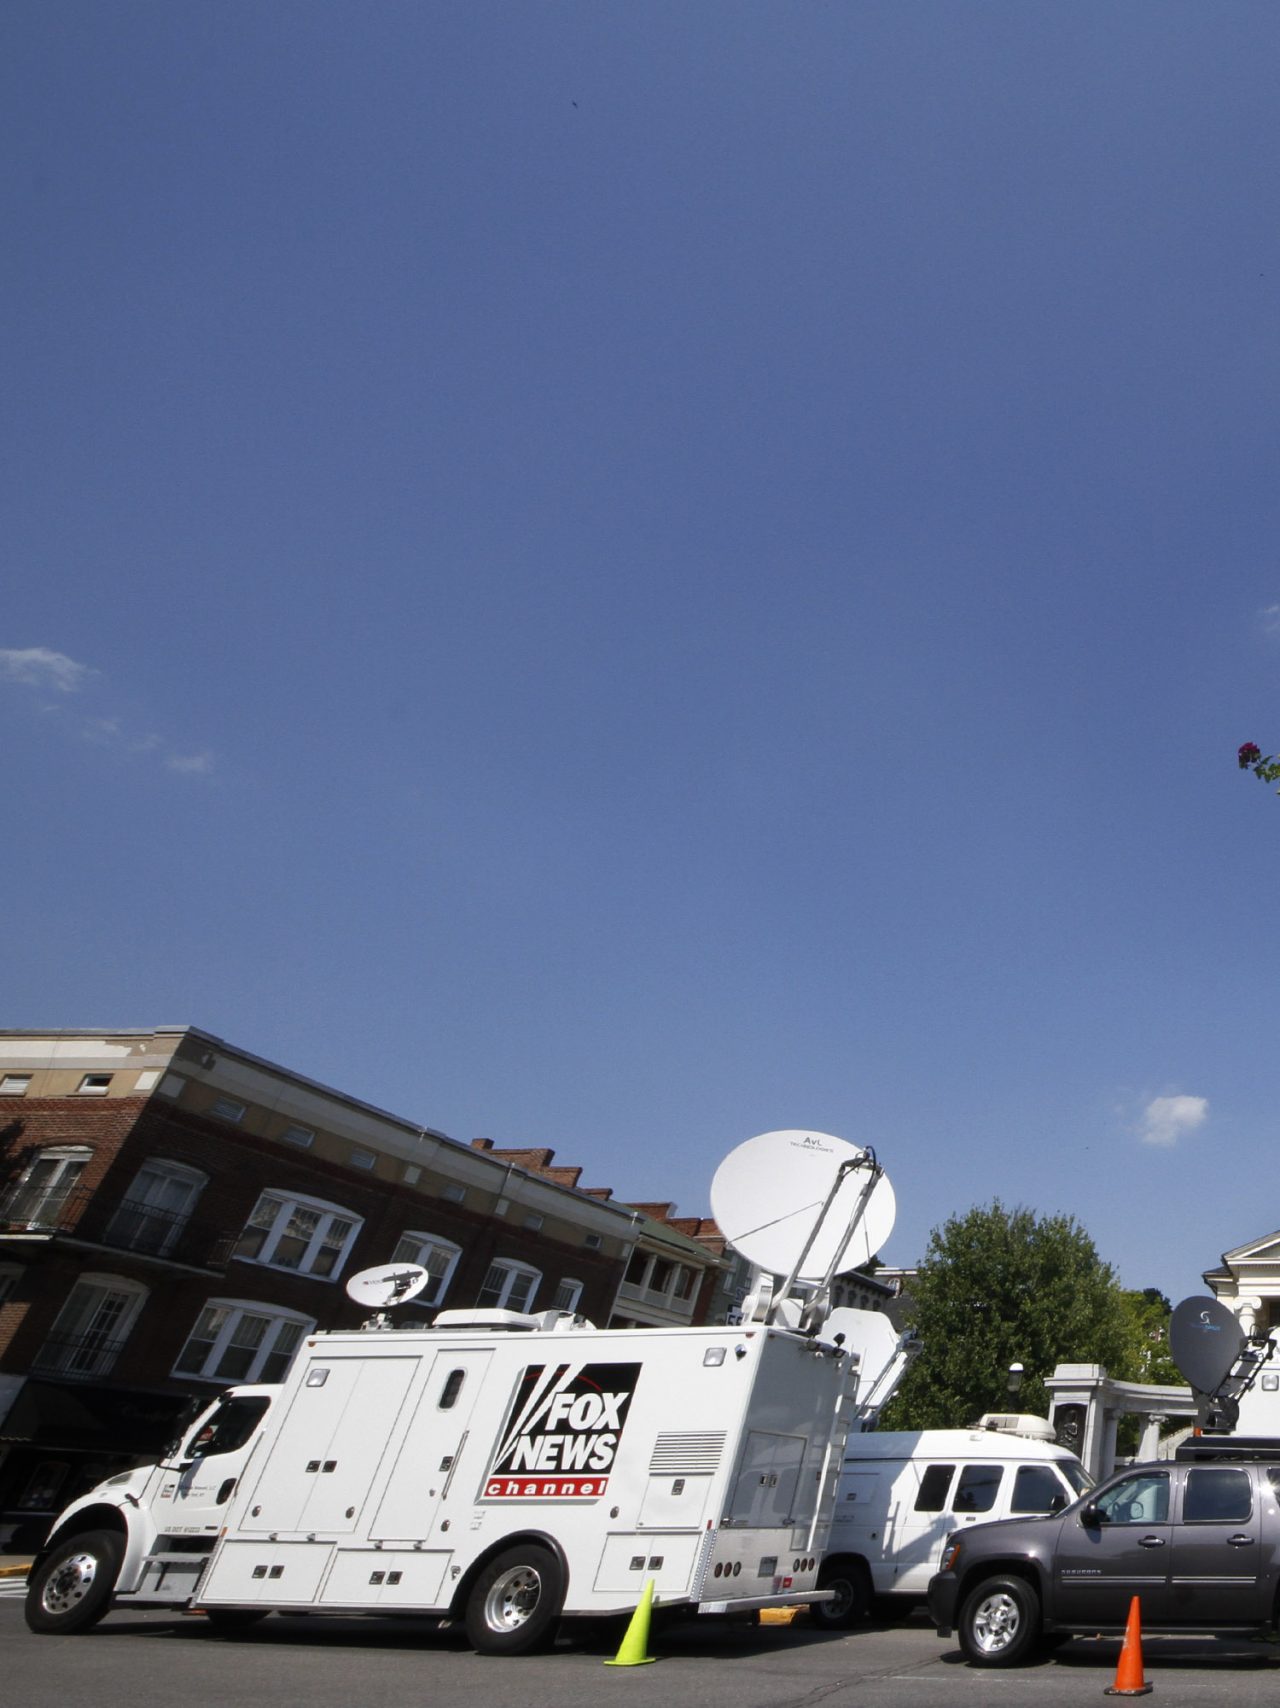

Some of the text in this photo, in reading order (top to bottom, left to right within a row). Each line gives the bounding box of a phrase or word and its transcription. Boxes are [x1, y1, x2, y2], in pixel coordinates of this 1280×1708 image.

[545, 1392, 630, 1431] FOX
[509, 1433, 617, 1471] NEWS
[487, 1480, 607, 1495] channel
